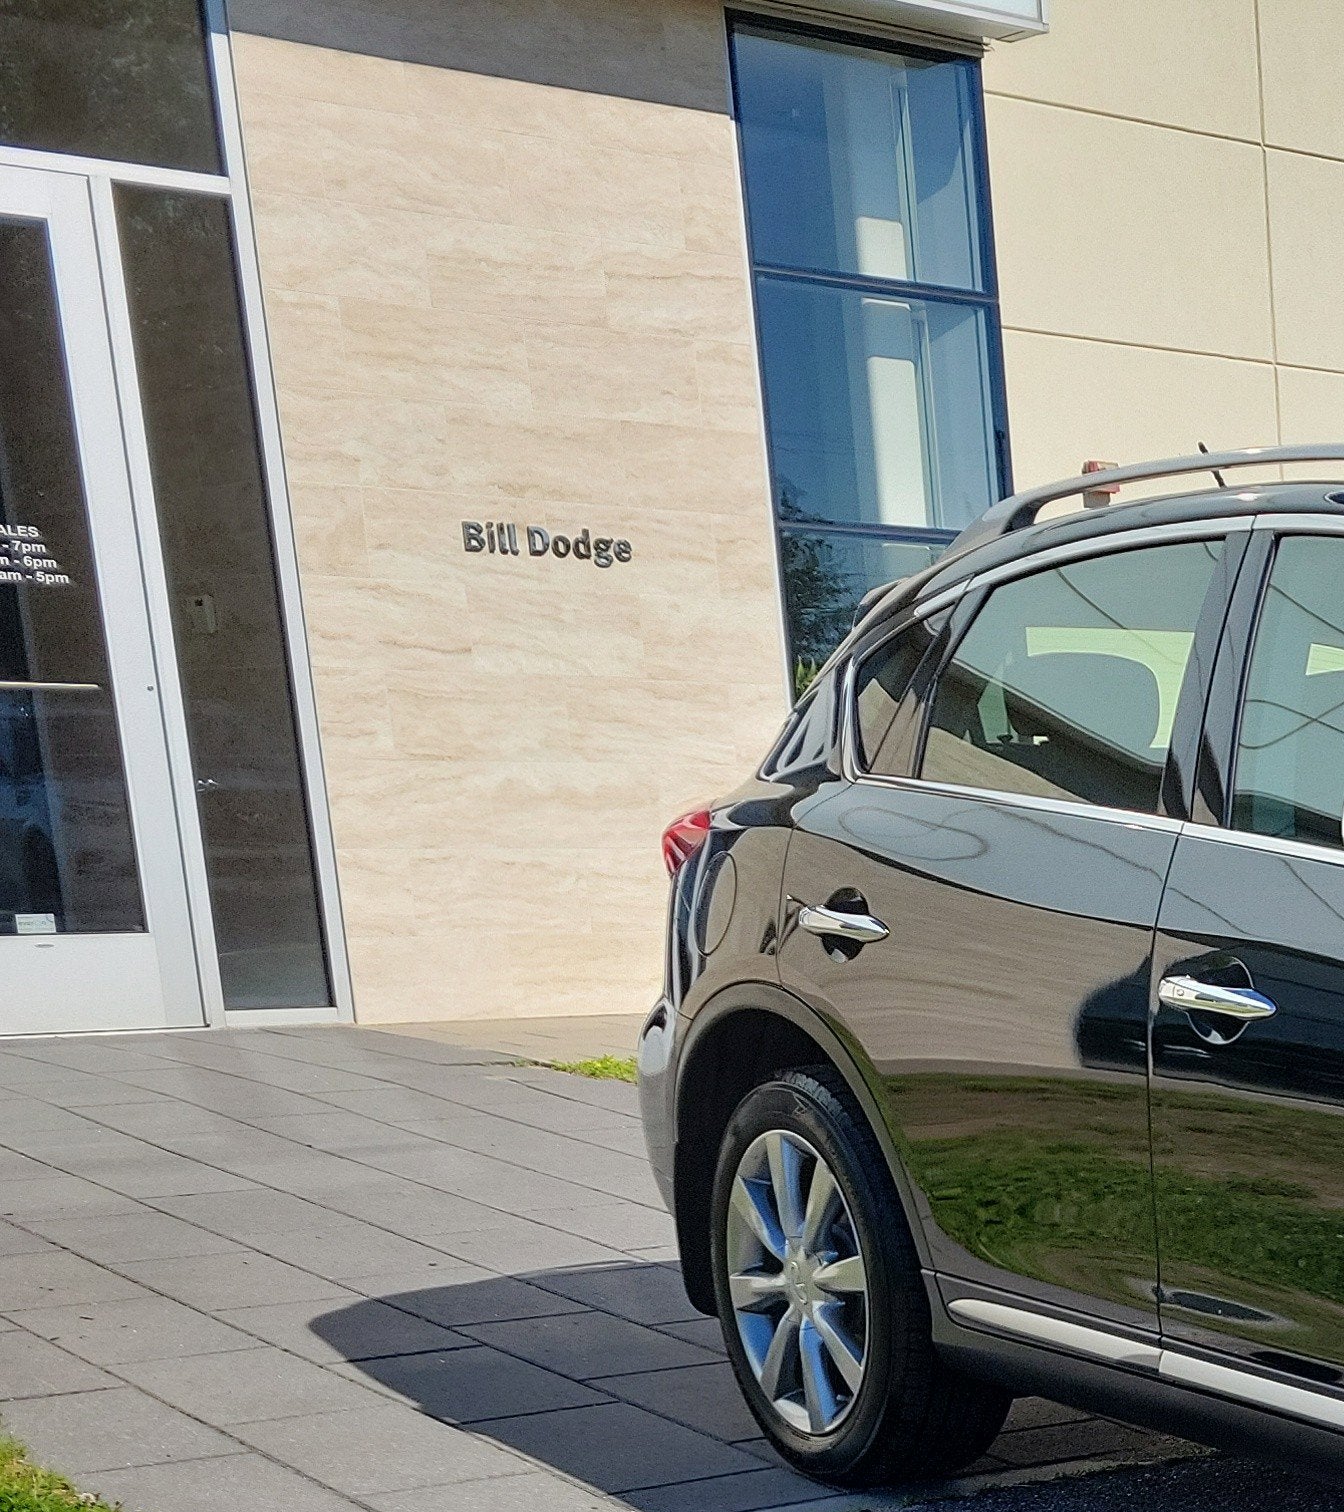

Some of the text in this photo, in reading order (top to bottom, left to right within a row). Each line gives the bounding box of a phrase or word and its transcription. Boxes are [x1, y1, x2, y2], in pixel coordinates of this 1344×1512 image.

[0, 524, 40, 537] ALES
[11, 540, 46, 553] 7pm
[461, 520, 632, 568] Bill Dodge
[23, 555, 57, 569] 6pm
[35, 571, 70, 584] 5pm
